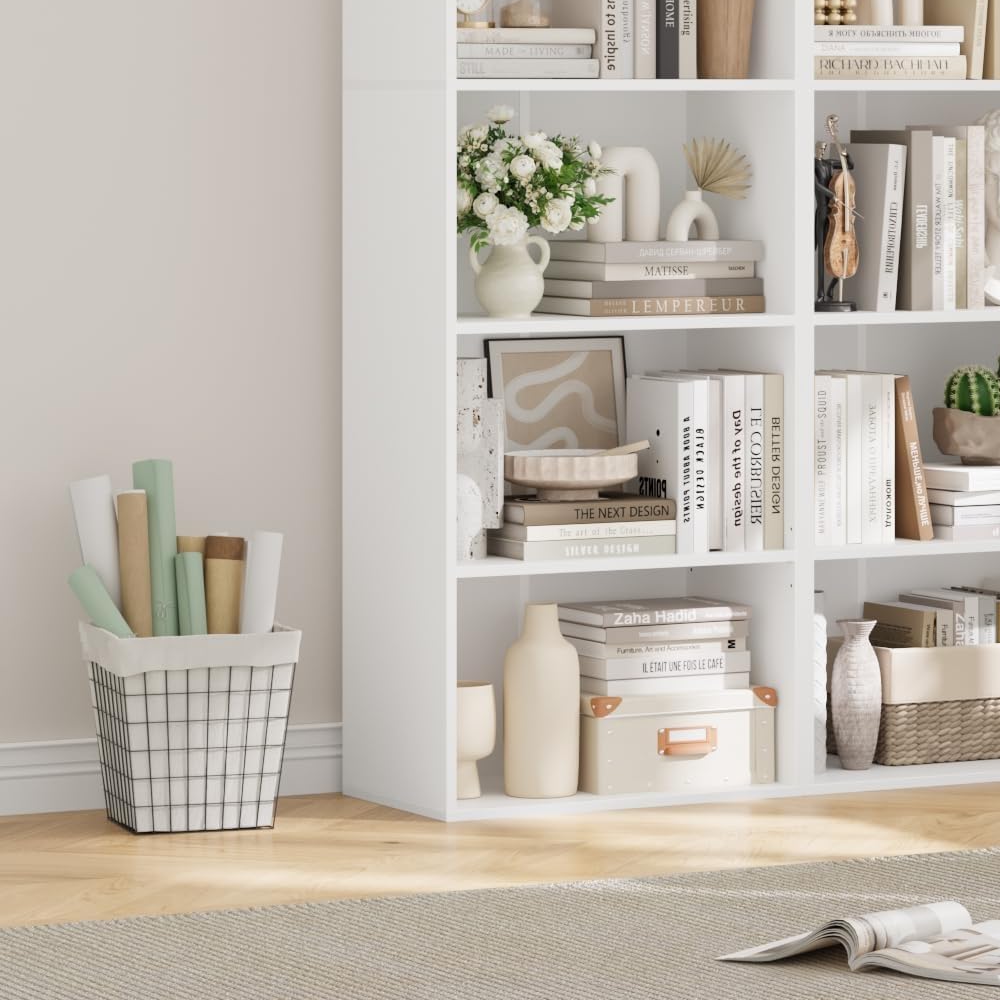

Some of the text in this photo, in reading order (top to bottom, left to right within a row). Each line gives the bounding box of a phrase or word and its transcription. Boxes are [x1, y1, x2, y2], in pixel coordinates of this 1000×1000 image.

[835, 30, 857, 38] МОГУ
[860, 29, 907, 38] ОБЪЯСНИТЬ
[820, 59, 879, 70] RICHARD
[644, 265, 689, 277] MATISSE
[632, 298, 745, 314] LEMPEREUR
[818, 390, 827, 476] PROUST SQUID
[574, 505, 670, 520] THE NEXT DESIGN
[917, 495, 928, 527] ЛУЧШЕ
[565, 543, 640, 556] SILVER DESIGN
[614, 612, 650, 624] Zaha
[655, 609, 696, 622] Hadid
[642, 659, 706, 673] IL UNE LE
